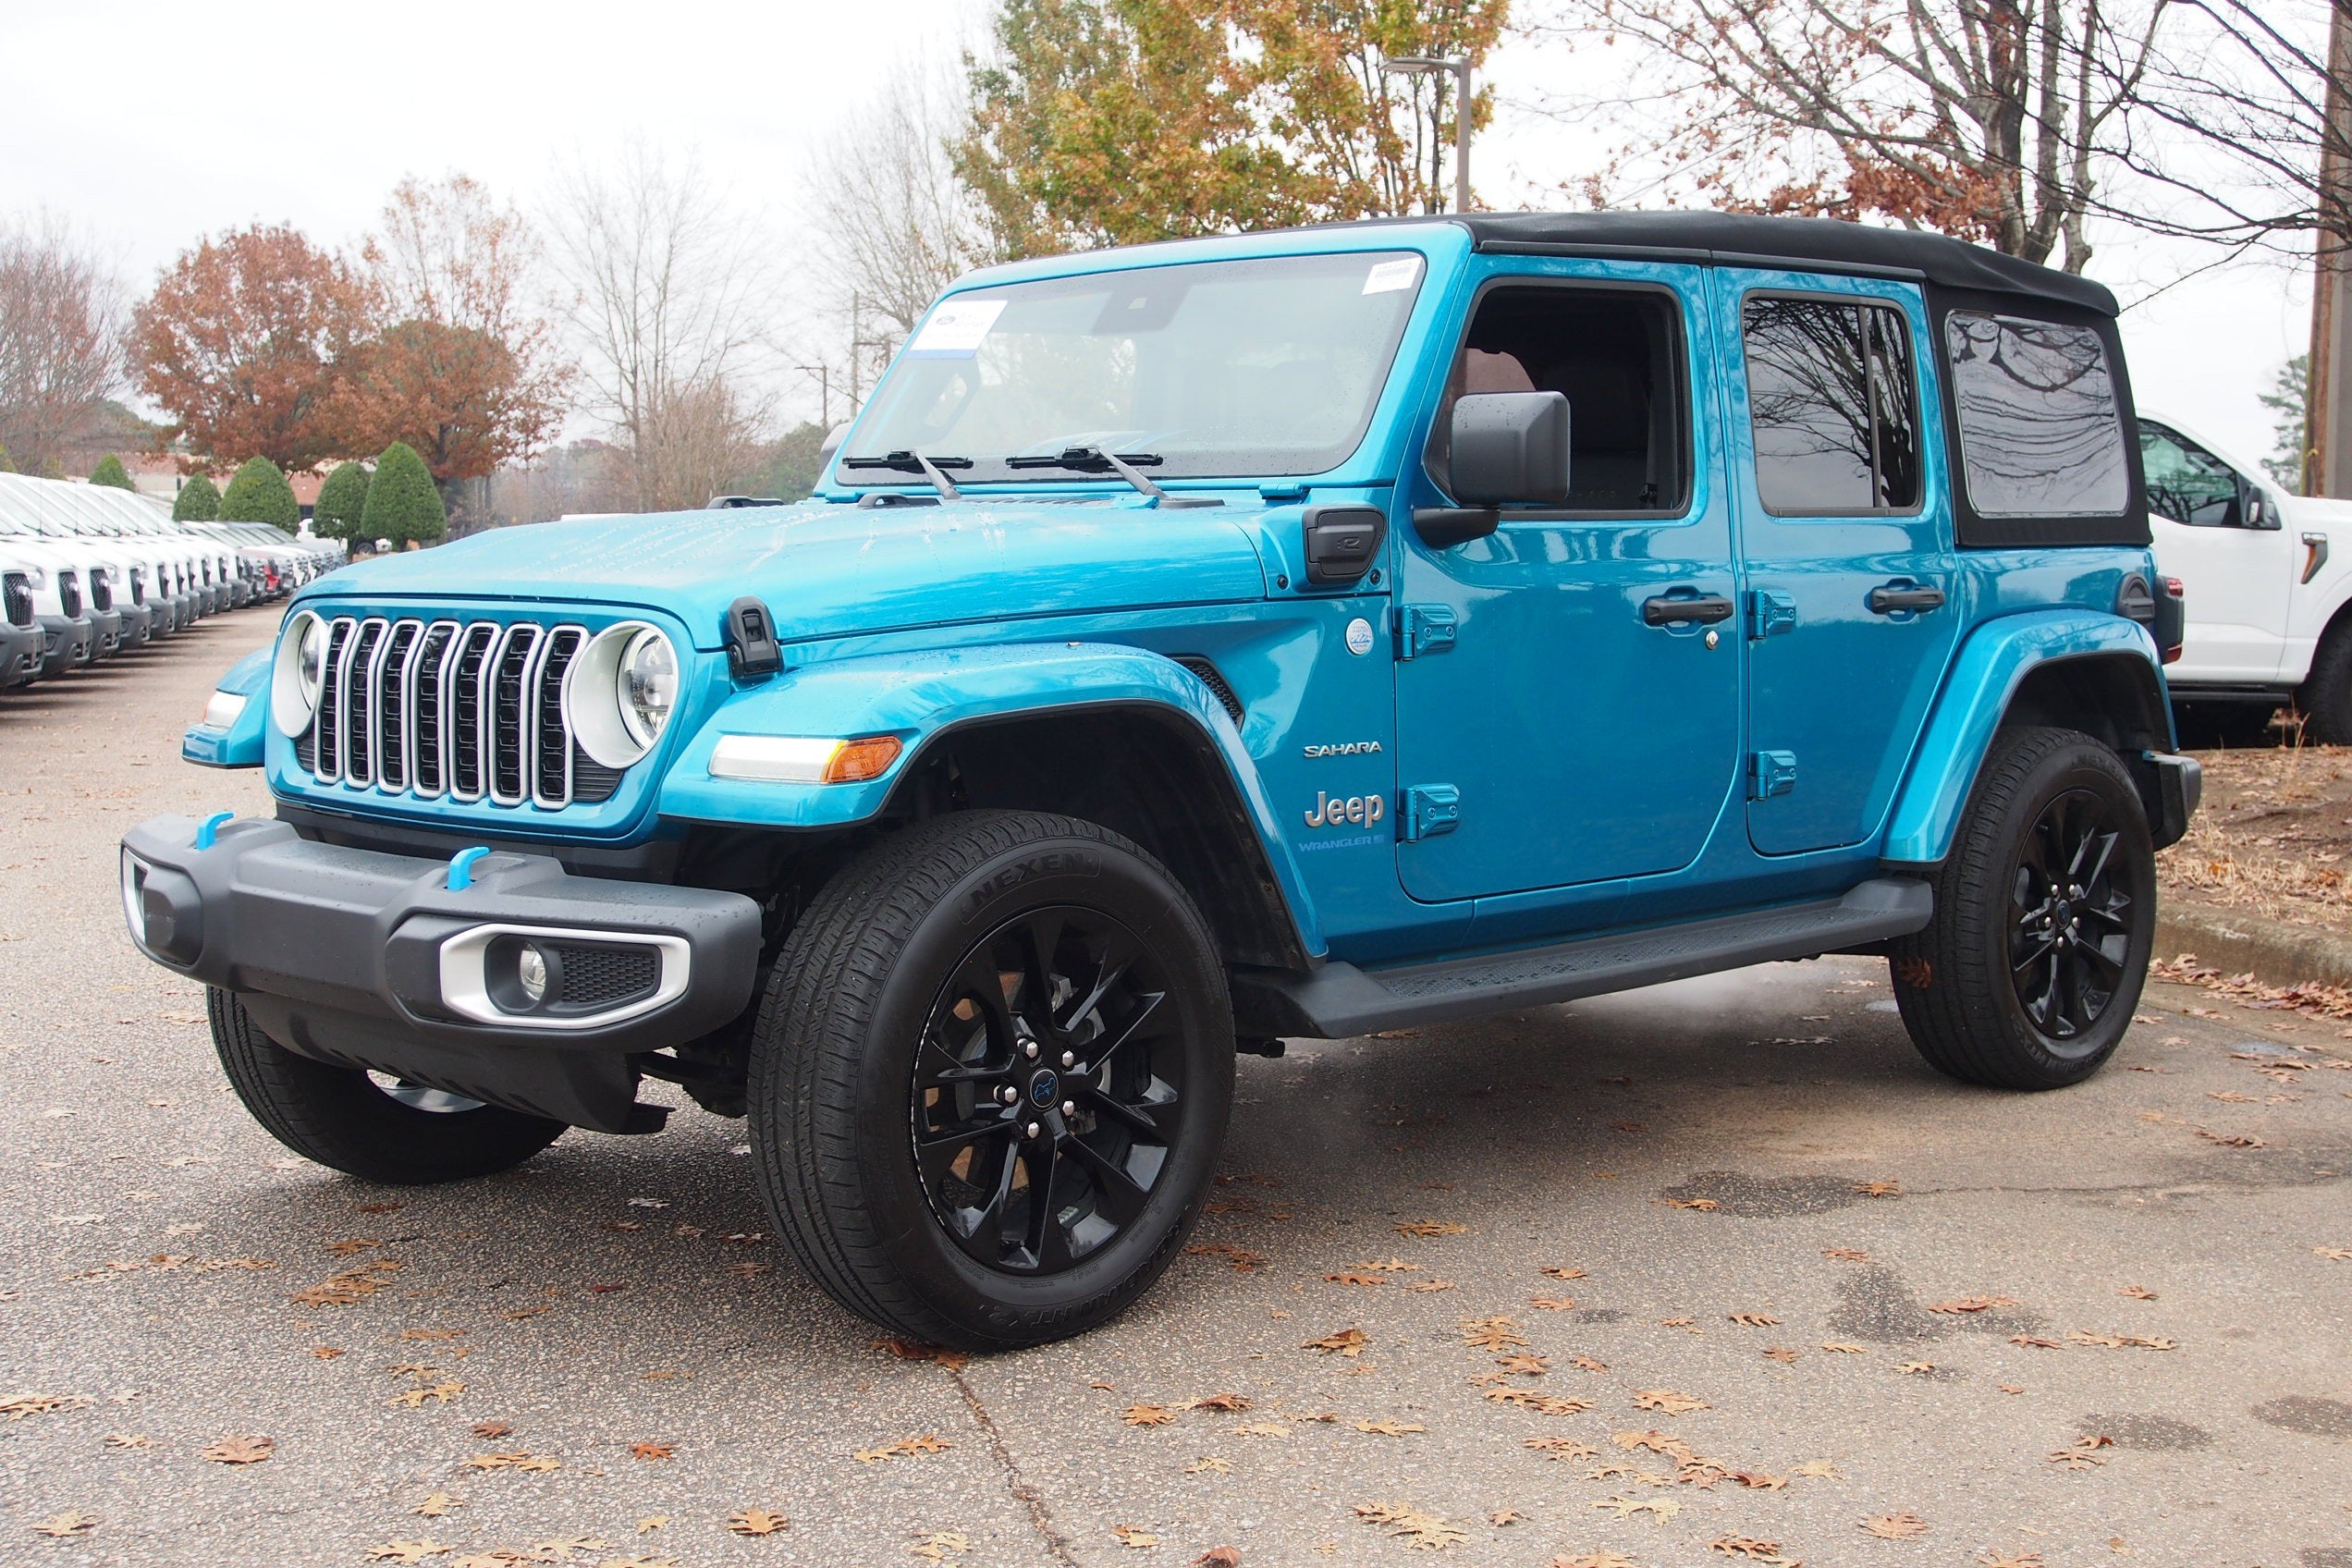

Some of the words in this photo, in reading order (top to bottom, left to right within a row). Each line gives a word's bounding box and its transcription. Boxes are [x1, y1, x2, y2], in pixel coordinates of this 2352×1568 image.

[1304, 741, 1382, 758] SAHARA
[1305, 790, 1384, 828] Jeep
[1298, 836, 1372, 852] WRANGLER
[970, 852, 1084, 906] NEXEN
